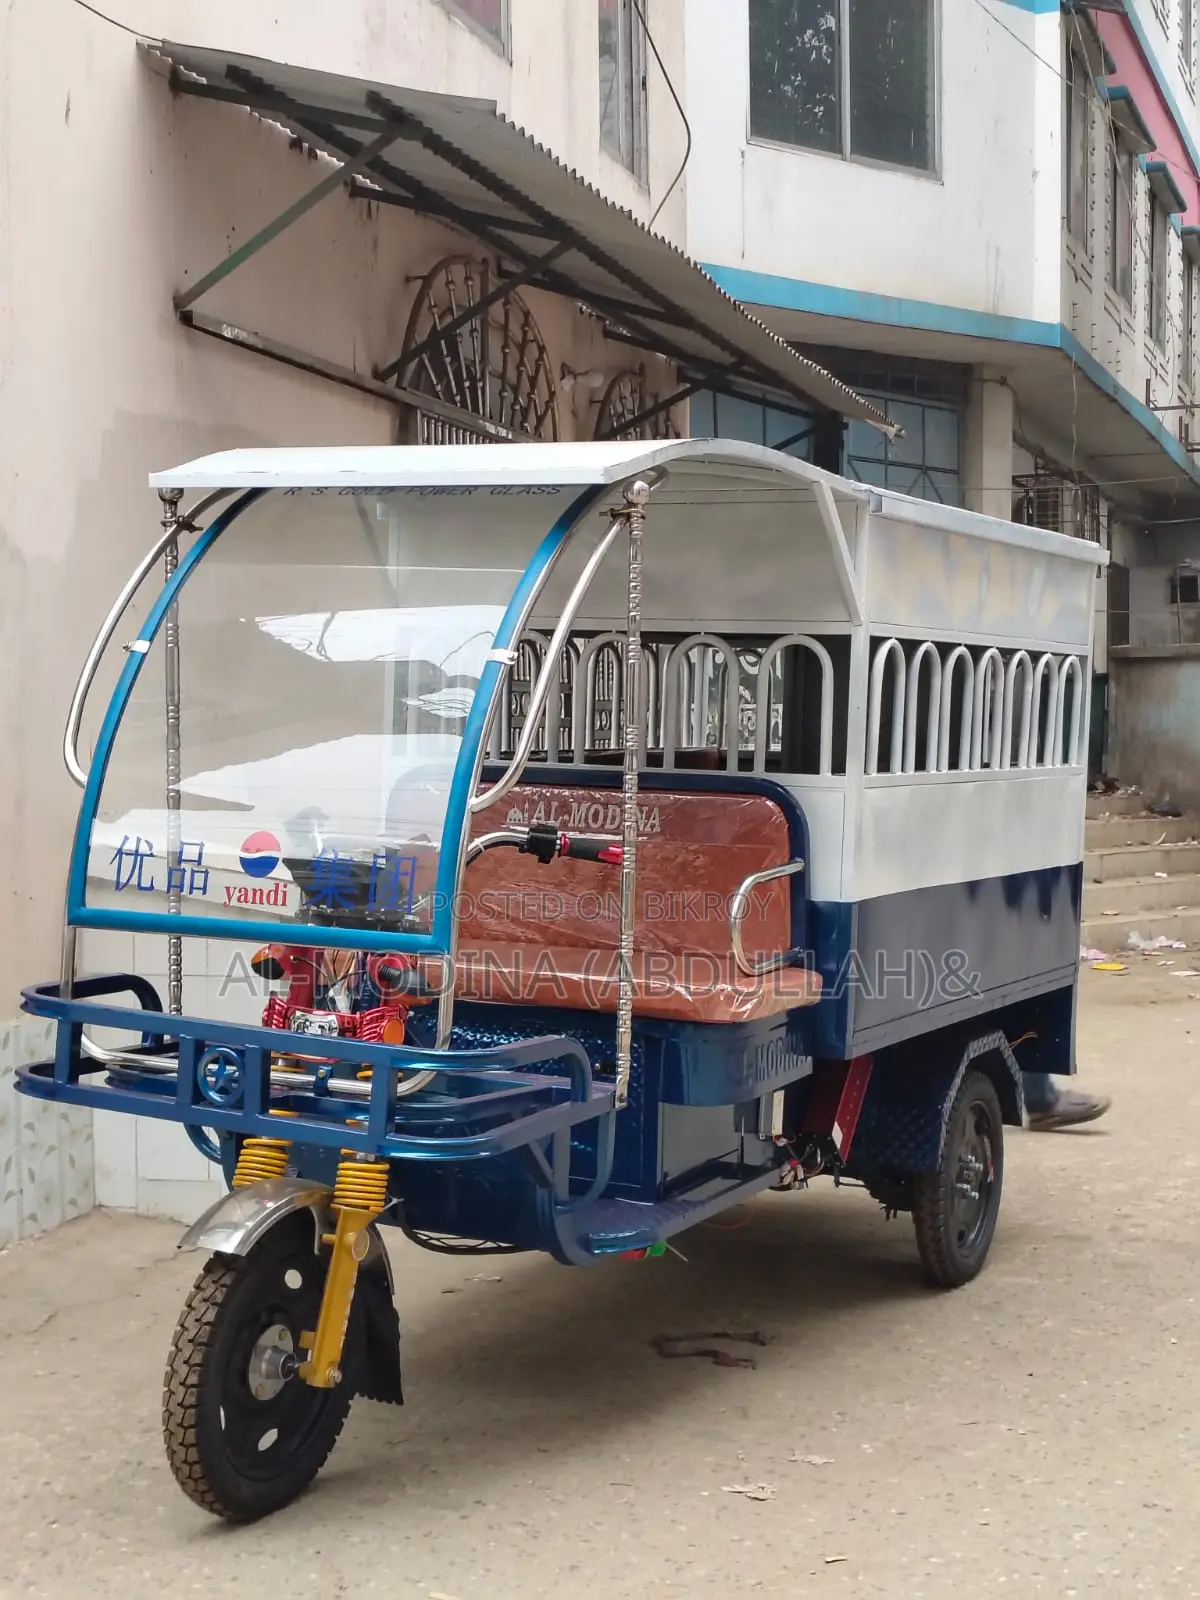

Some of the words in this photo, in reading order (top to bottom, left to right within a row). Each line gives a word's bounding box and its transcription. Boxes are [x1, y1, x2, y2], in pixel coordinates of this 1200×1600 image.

[490, 485, 565, 496] GLASS
[531, 800, 661, 833] AL-MODNA
[109, 834, 209, 895] 优品
[224, 882, 288, 907] yandi
